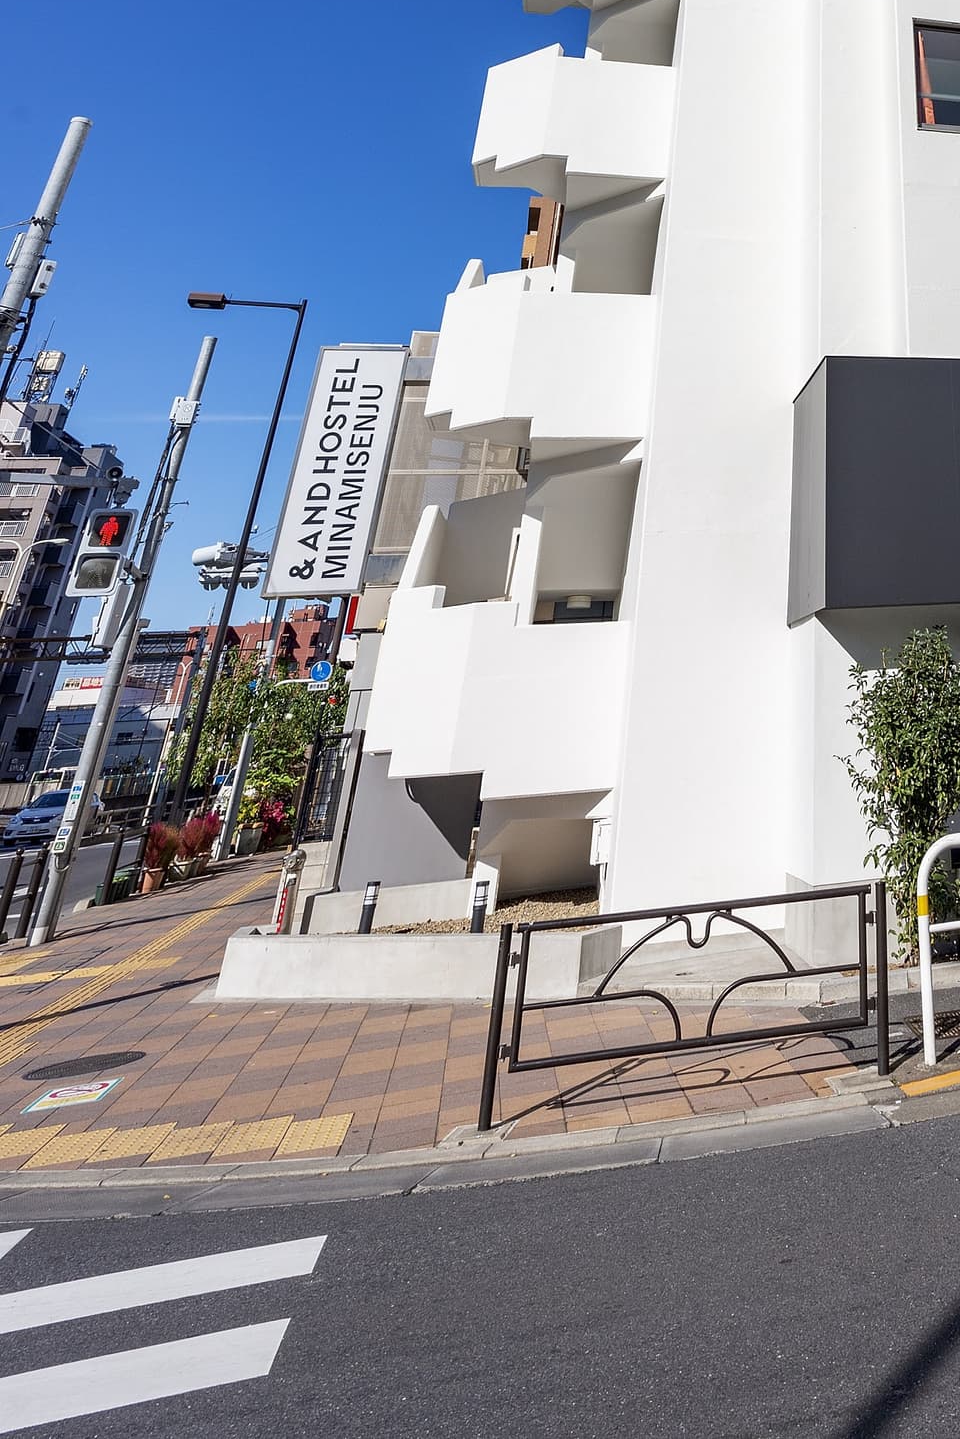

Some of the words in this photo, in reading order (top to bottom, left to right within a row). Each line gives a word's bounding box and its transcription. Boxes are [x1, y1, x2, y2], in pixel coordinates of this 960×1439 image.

[312, 358, 360, 474] HOSTEL
[297, 482, 331, 552] AND
[320, 384, 384, 579] MINAMISENJU
[288, 557, 317, 580] &
